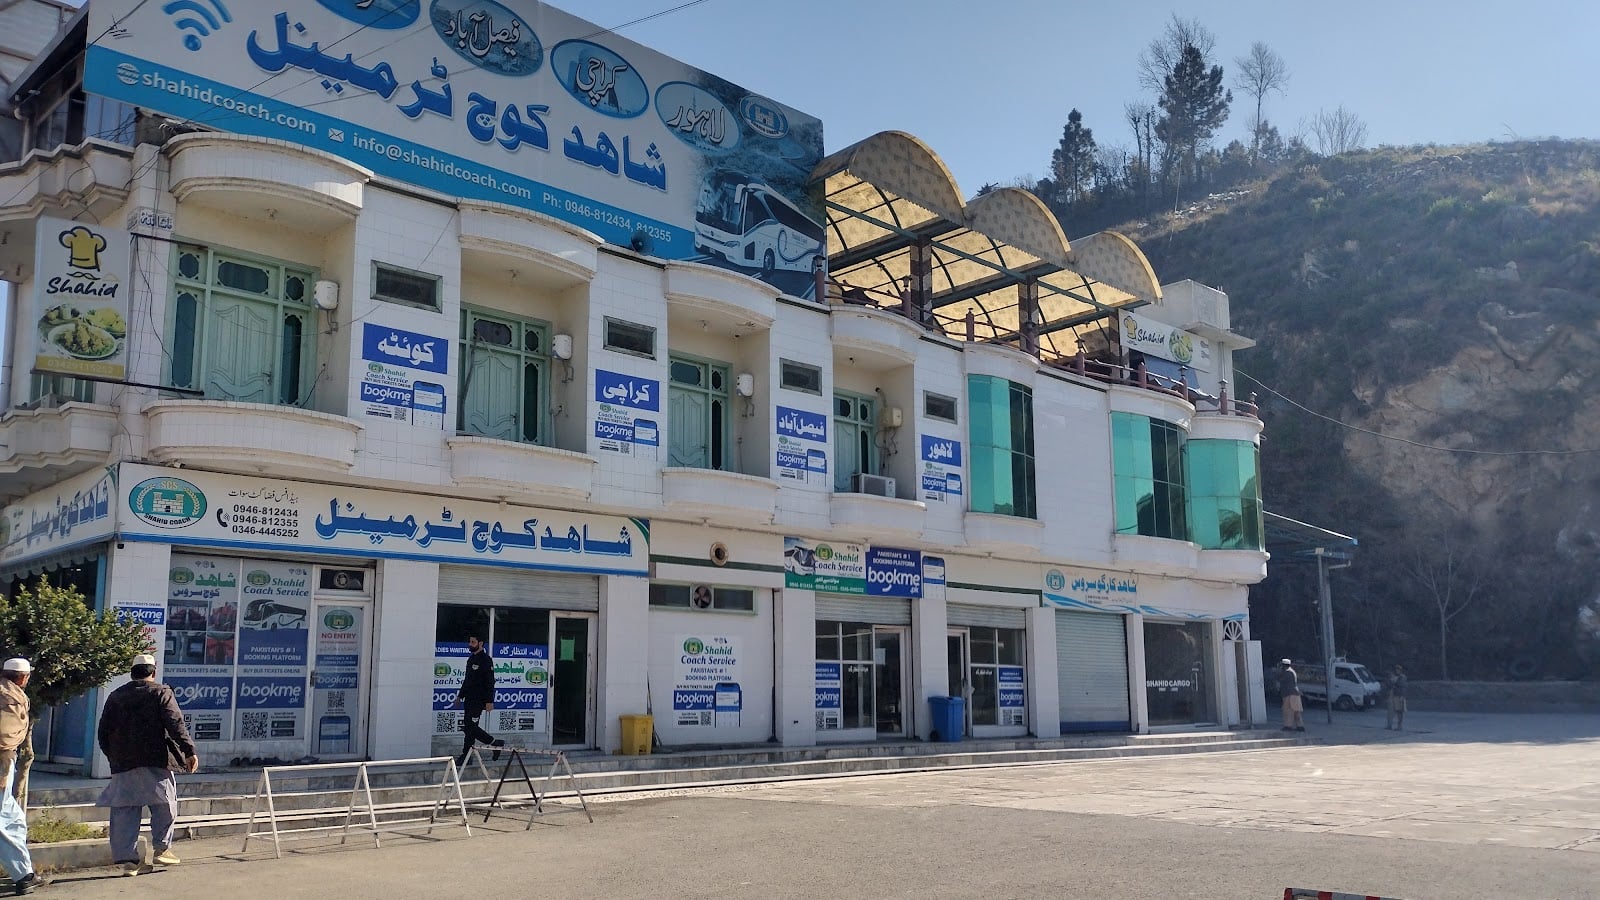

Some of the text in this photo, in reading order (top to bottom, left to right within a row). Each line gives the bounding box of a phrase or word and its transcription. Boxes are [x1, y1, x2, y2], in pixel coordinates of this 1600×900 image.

[469, 14, 521, 57] فیصل
[575, 56, 629, 106] کراچی
[142, 71, 317, 135] shahidcoach.com
[246, 11, 668, 192] شاہد کوچ ٹرمینل
[666, 104, 726, 144] لاہور
[352, 132, 532, 200] info@shahidcoach.com
[543, 191, 562, 210] Ph:
[636, 222, 672, 243] 812355
[46, 276, 119, 299] Shahid
[1137, 328, 1165, 345] Shahid
[377, 331, 435, 366] کوئٹہ
[366, 371, 409, 384] Coach Service
[384, 367, 406, 378] Shahid
[364, 384, 412, 401] bookme
[602, 380, 650, 405] کراچی
[597, 422, 633, 438] bookme
[778, 412, 825, 438] فیصل آباد
[778, 452, 807, 466] bookme
[927, 442, 953, 460] لاہور
[78, 479, 108, 522] شاہد
[59, 488, 80, 537] کوچ
[233, 503, 299, 518] 0946-812434
[143, 512, 191, 527] SHAHID COACH
[232, 513, 299, 528] 0946-812355
[315, 497, 633, 557] شاہد کوچ ٹرمینل
[231, 524, 300, 538] 0346-4445252
[833, 552, 859, 563] Shahid
[815, 561, 863, 573] Coach Service
[195, 572, 236, 587] شاہد
[271, 577, 305, 588] Shahid
[867, 566, 921, 588] bookme
[1071, 573, 1137, 594] شاہد کارگو سروس
[172, 588, 220, 599] کوچ سروس
[243, 585, 309, 597] Coach Service
[243, 653, 271, 661] BOOKING
[704, 645, 733, 656] Shahid
[493, 660, 525, 674] شاہد
[681, 655, 737, 666] Coach Service
[240, 682, 301, 698] bookme
[1146, 679, 1169, 688] SHAHID
[493, 688, 544, 704] bookme
[675, 692, 714, 706] bookme
